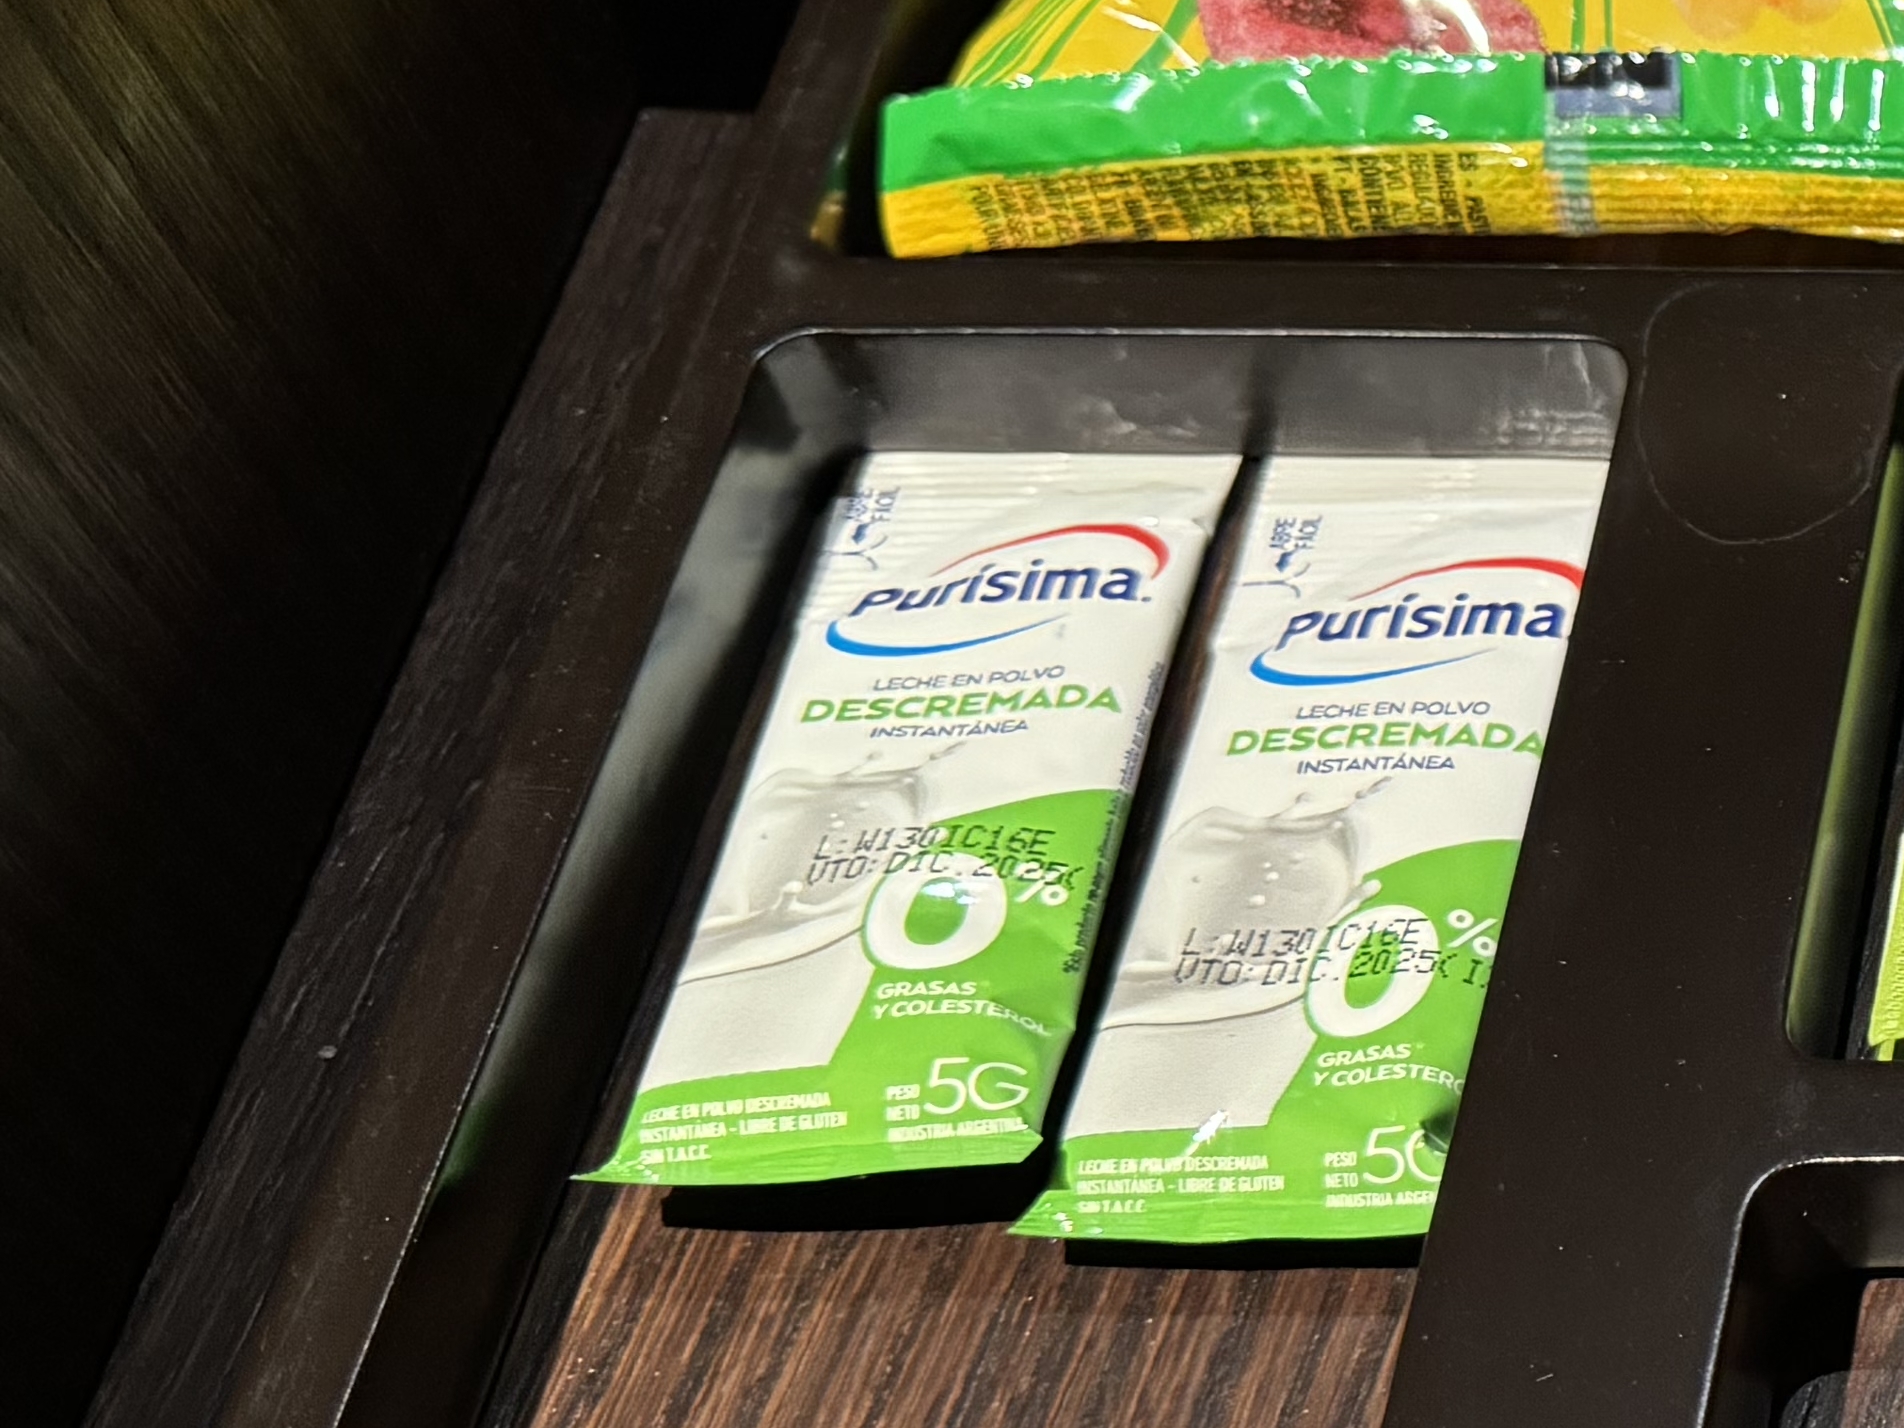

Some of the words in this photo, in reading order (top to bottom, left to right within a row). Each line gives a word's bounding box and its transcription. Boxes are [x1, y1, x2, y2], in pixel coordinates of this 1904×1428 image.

[1274, 593, 1566, 651] Purísima
[873, 674, 948, 691] LECHE
[952, 673, 983, 688] EN
[989, 665, 1065, 683] POLVO
[800, 684, 1122, 722] DESCREMADA
[1296, 702, 1371, 719] LECHE
[1374, 701, 1405, 716] EN
[1412, 700, 1490, 716] POLVO
[870, 719, 1029, 738] INSTANTÁNEA
[1226, 722, 1544, 760] DESCREMADA
[1297, 753, 1456, 774] INSTANTÁNEA
[877, 980, 977, 1000] GRASAS
[874, 1004, 889, 1019] Y
[891, 1000, 1052, 1037] COLESTEROL
[1317, 1044, 1412, 1068] GRASAS
[923, 1056, 1030, 1115] 5G
[1313, 1072, 1330, 1086] Y
[1324, 1151, 1357, 1167] PESO
[1324, 1172, 1359, 1188] NETO
